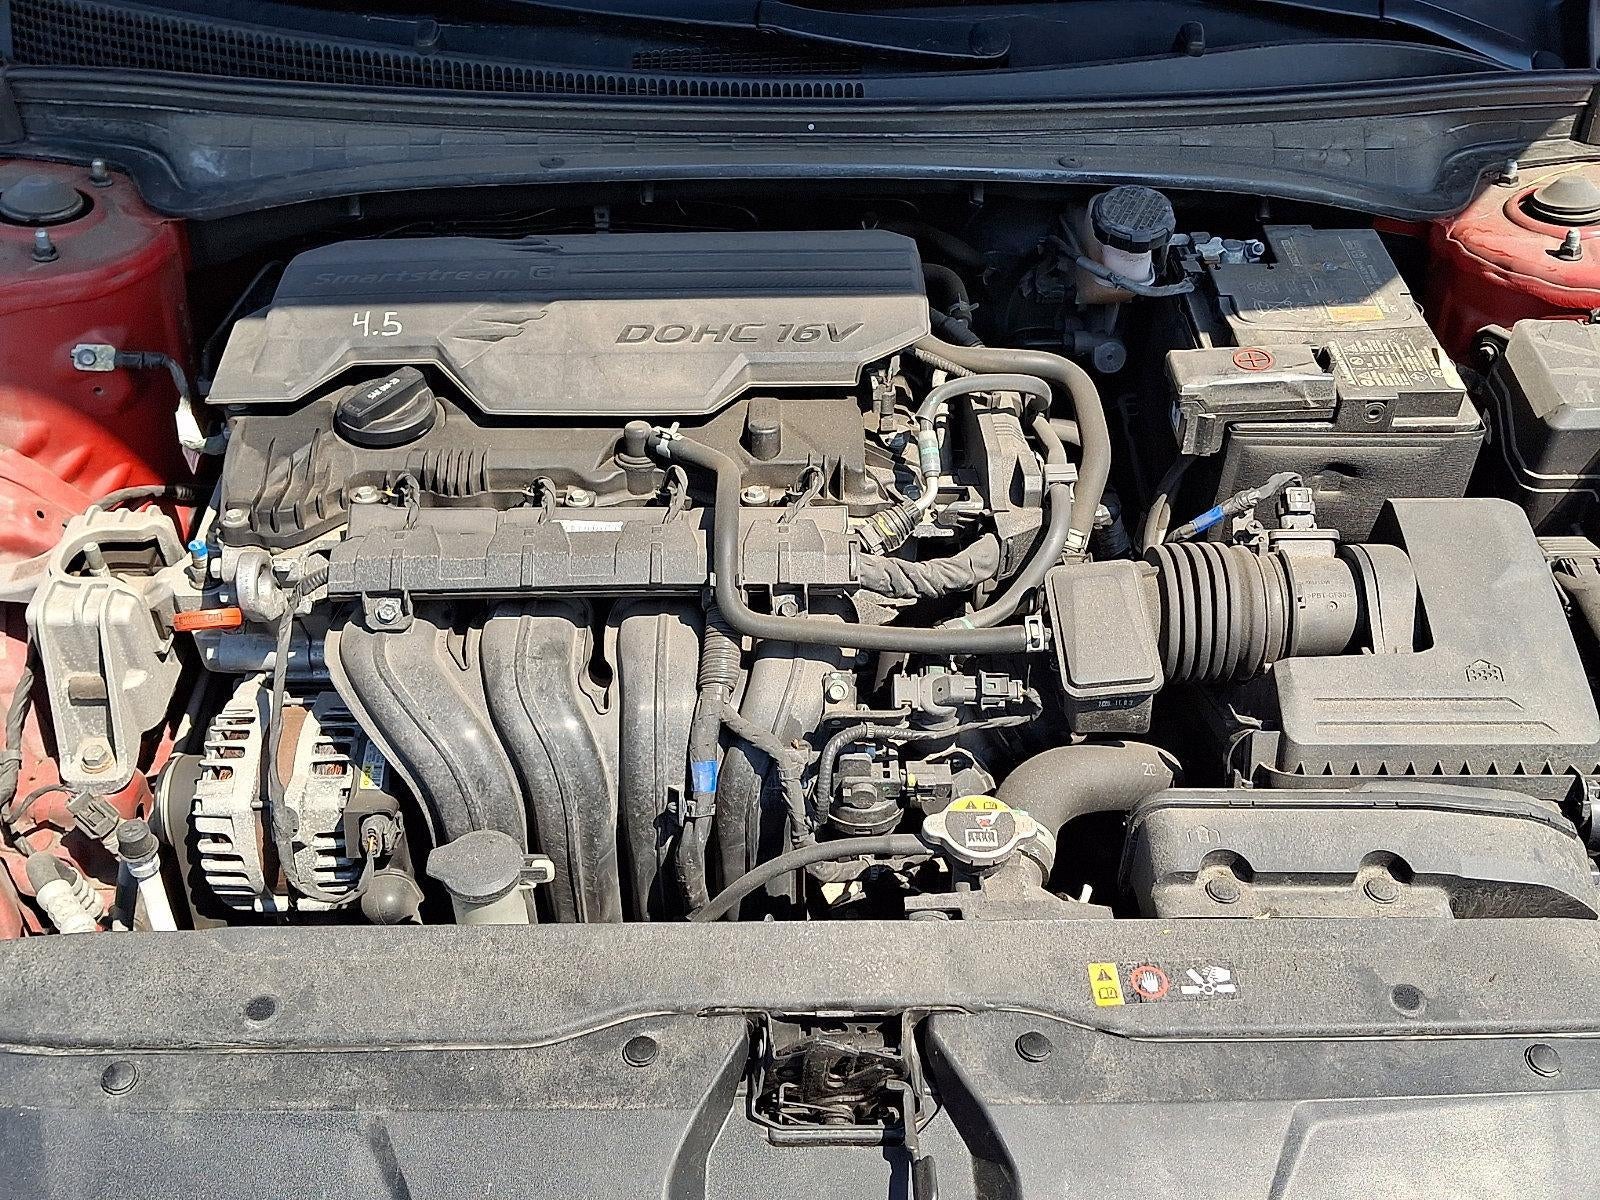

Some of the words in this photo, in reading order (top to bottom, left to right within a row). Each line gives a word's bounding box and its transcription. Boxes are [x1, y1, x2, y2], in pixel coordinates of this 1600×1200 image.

[314, 268, 520, 286] Smartstream
[352, 310, 403, 337] 4.5
[615, 322, 766, 343] DOHC
[777, 322, 864, 343] 16V
